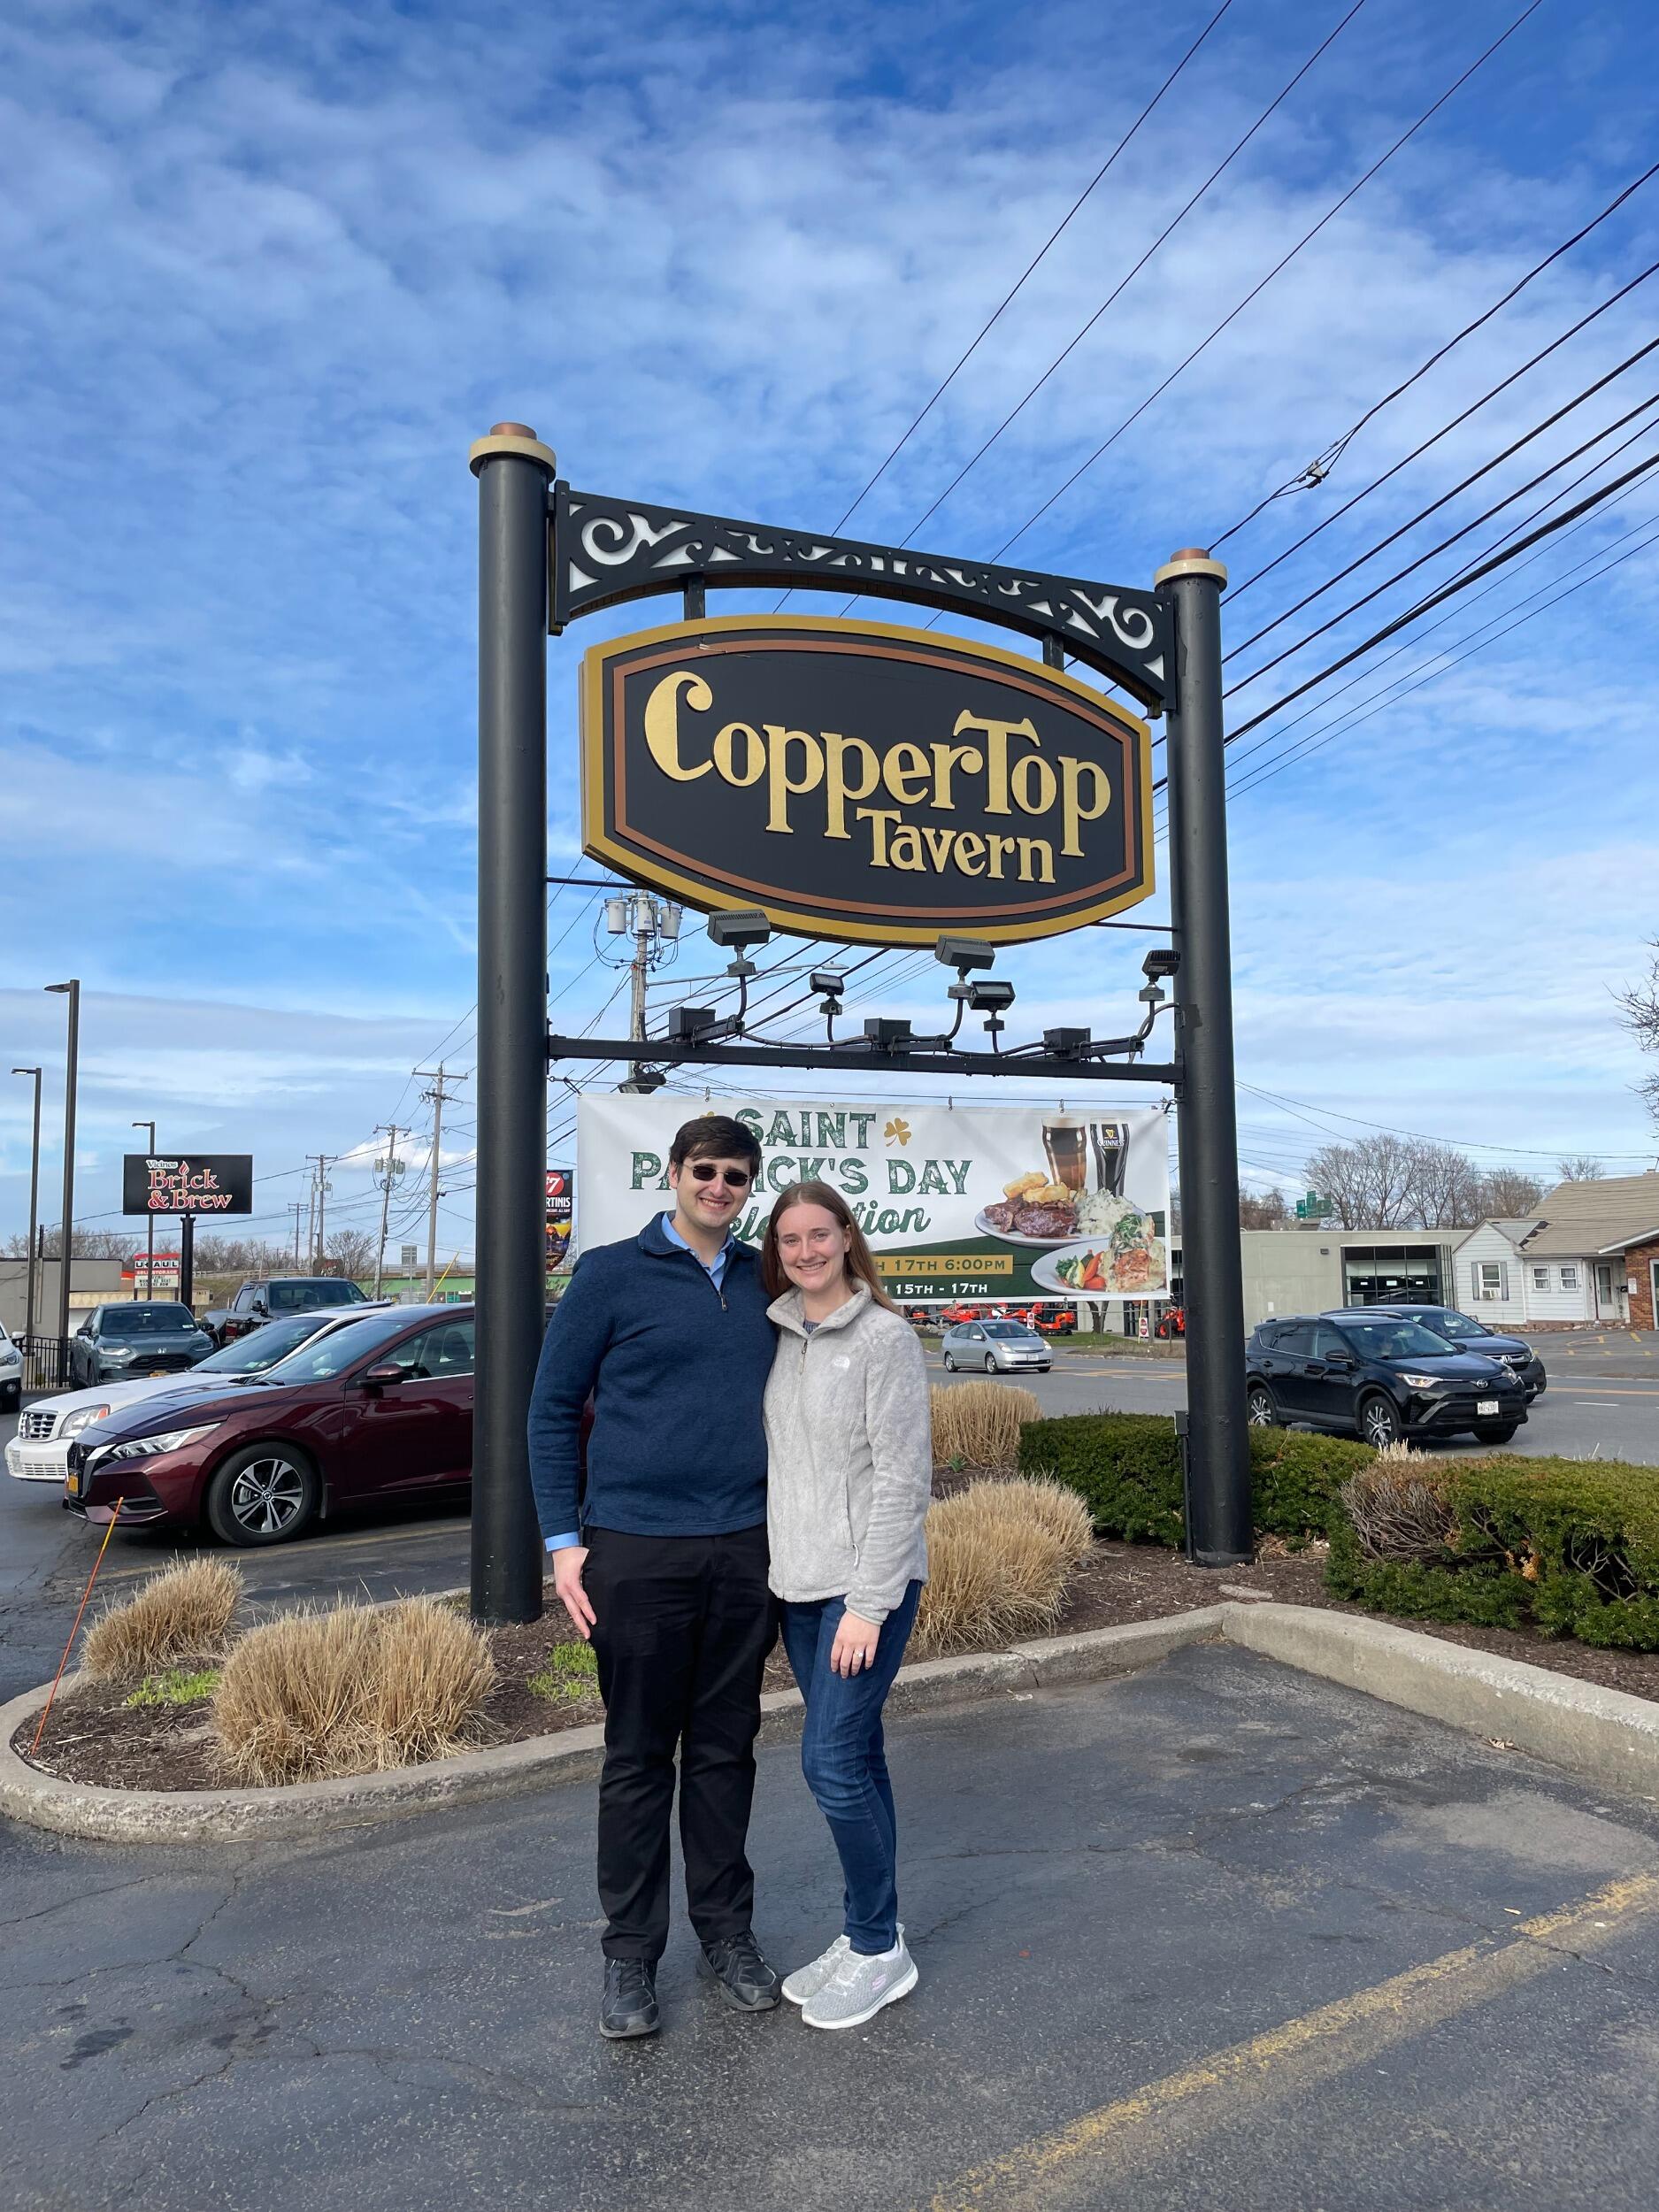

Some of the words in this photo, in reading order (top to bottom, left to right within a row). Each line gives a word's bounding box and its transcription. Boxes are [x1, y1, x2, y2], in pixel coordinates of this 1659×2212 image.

[644, 671, 1111, 856] CopperTop
[856, 807, 1056, 883] Tavern
[735, 1108, 876, 1148] SAINT
[148, 1168, 219, 1189] Brick
[886, 1158, 973, 1195] DAY
[170, 1189, 233, 1209] Brew
[546, 1197, 571, 1208] RTINIS
[895, 1259, 938, 1271] 17TH
[945, 1259, 1005, 1271] 6:00PM
[895, 1283, 933, 1294] 15TH
[951, 1283, 988, 1294] 17TH
